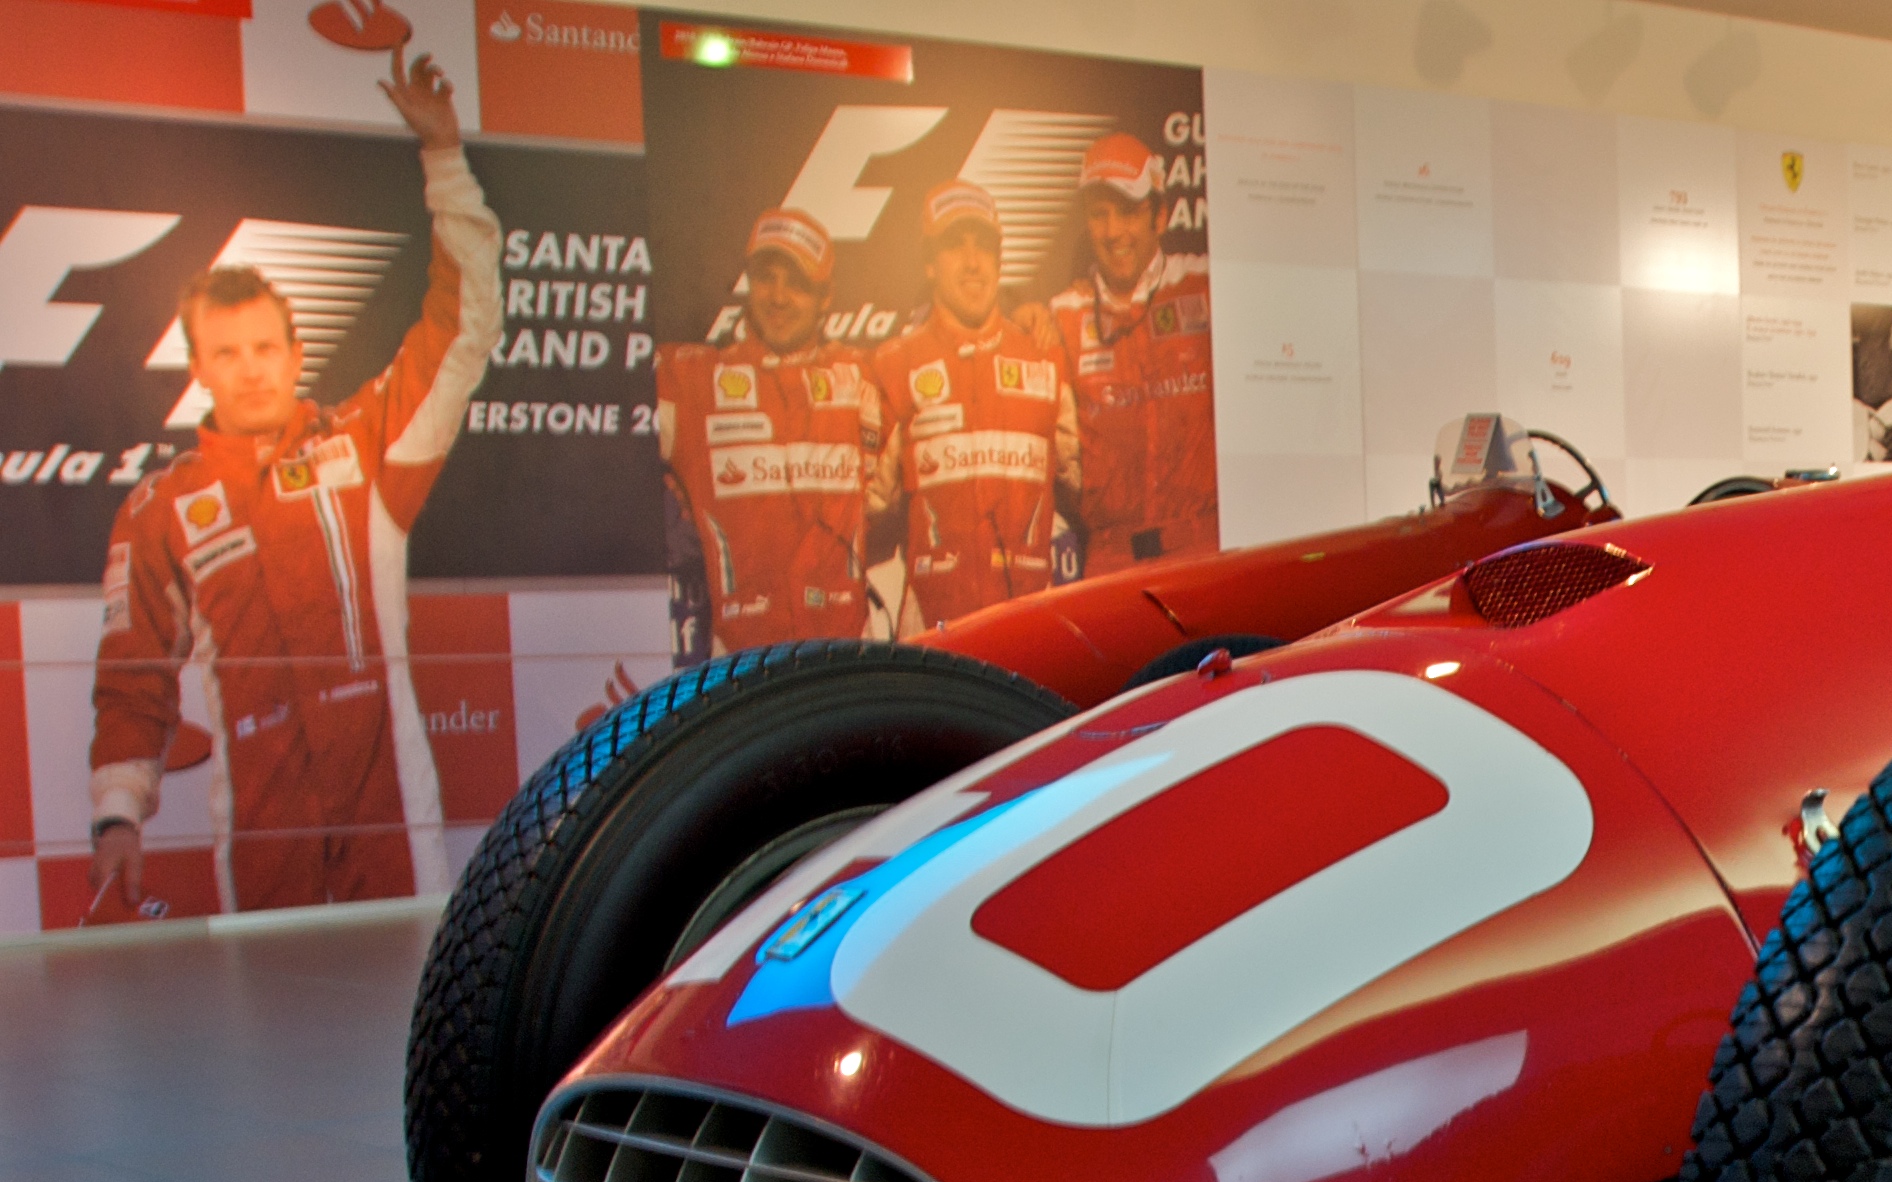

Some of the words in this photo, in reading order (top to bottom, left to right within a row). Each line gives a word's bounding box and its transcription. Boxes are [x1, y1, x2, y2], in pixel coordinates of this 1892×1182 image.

[504, 229, 652, 274] SANTA
[502, 278, 647, 323] RITISH
[0, 442, 104, 486] ula
